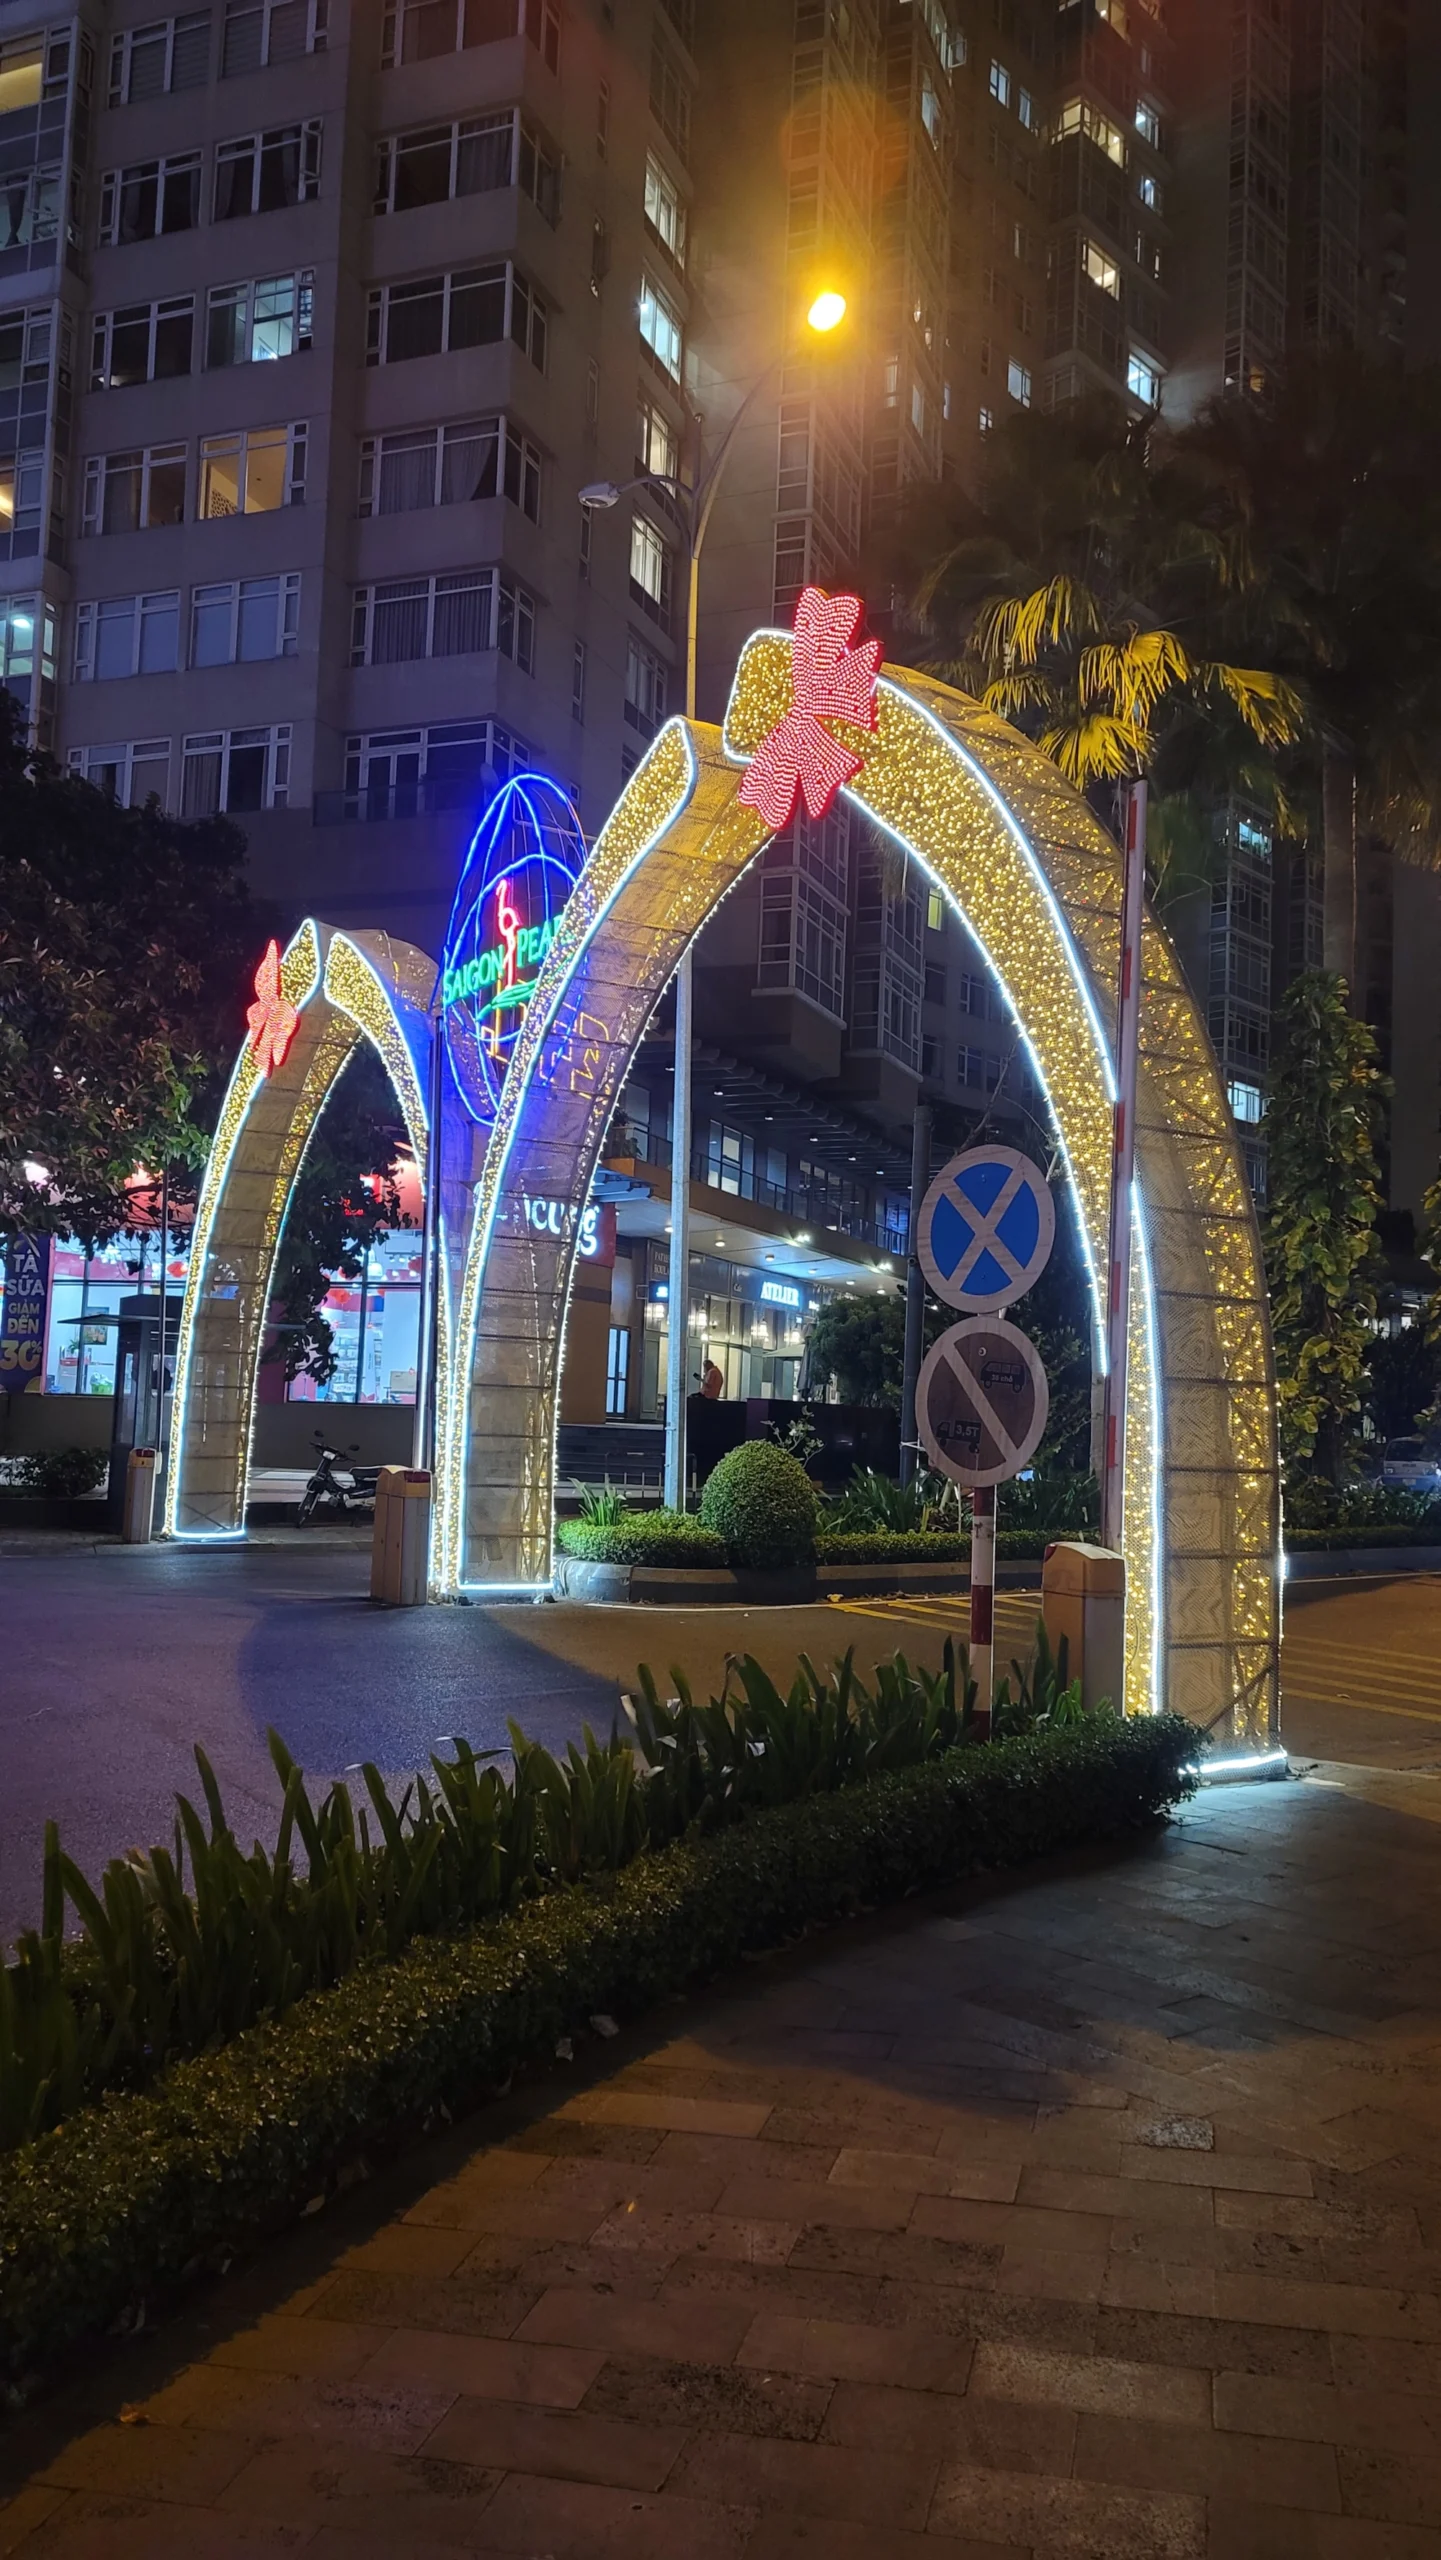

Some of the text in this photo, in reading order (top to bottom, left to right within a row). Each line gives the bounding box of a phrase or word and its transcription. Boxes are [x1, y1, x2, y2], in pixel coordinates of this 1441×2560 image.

[443, 913, 573, 1007] SAIGON PEA
[760, 1281, 800, 1308] ATELIER
[956, 1424, 980, 1437] 3,5T
